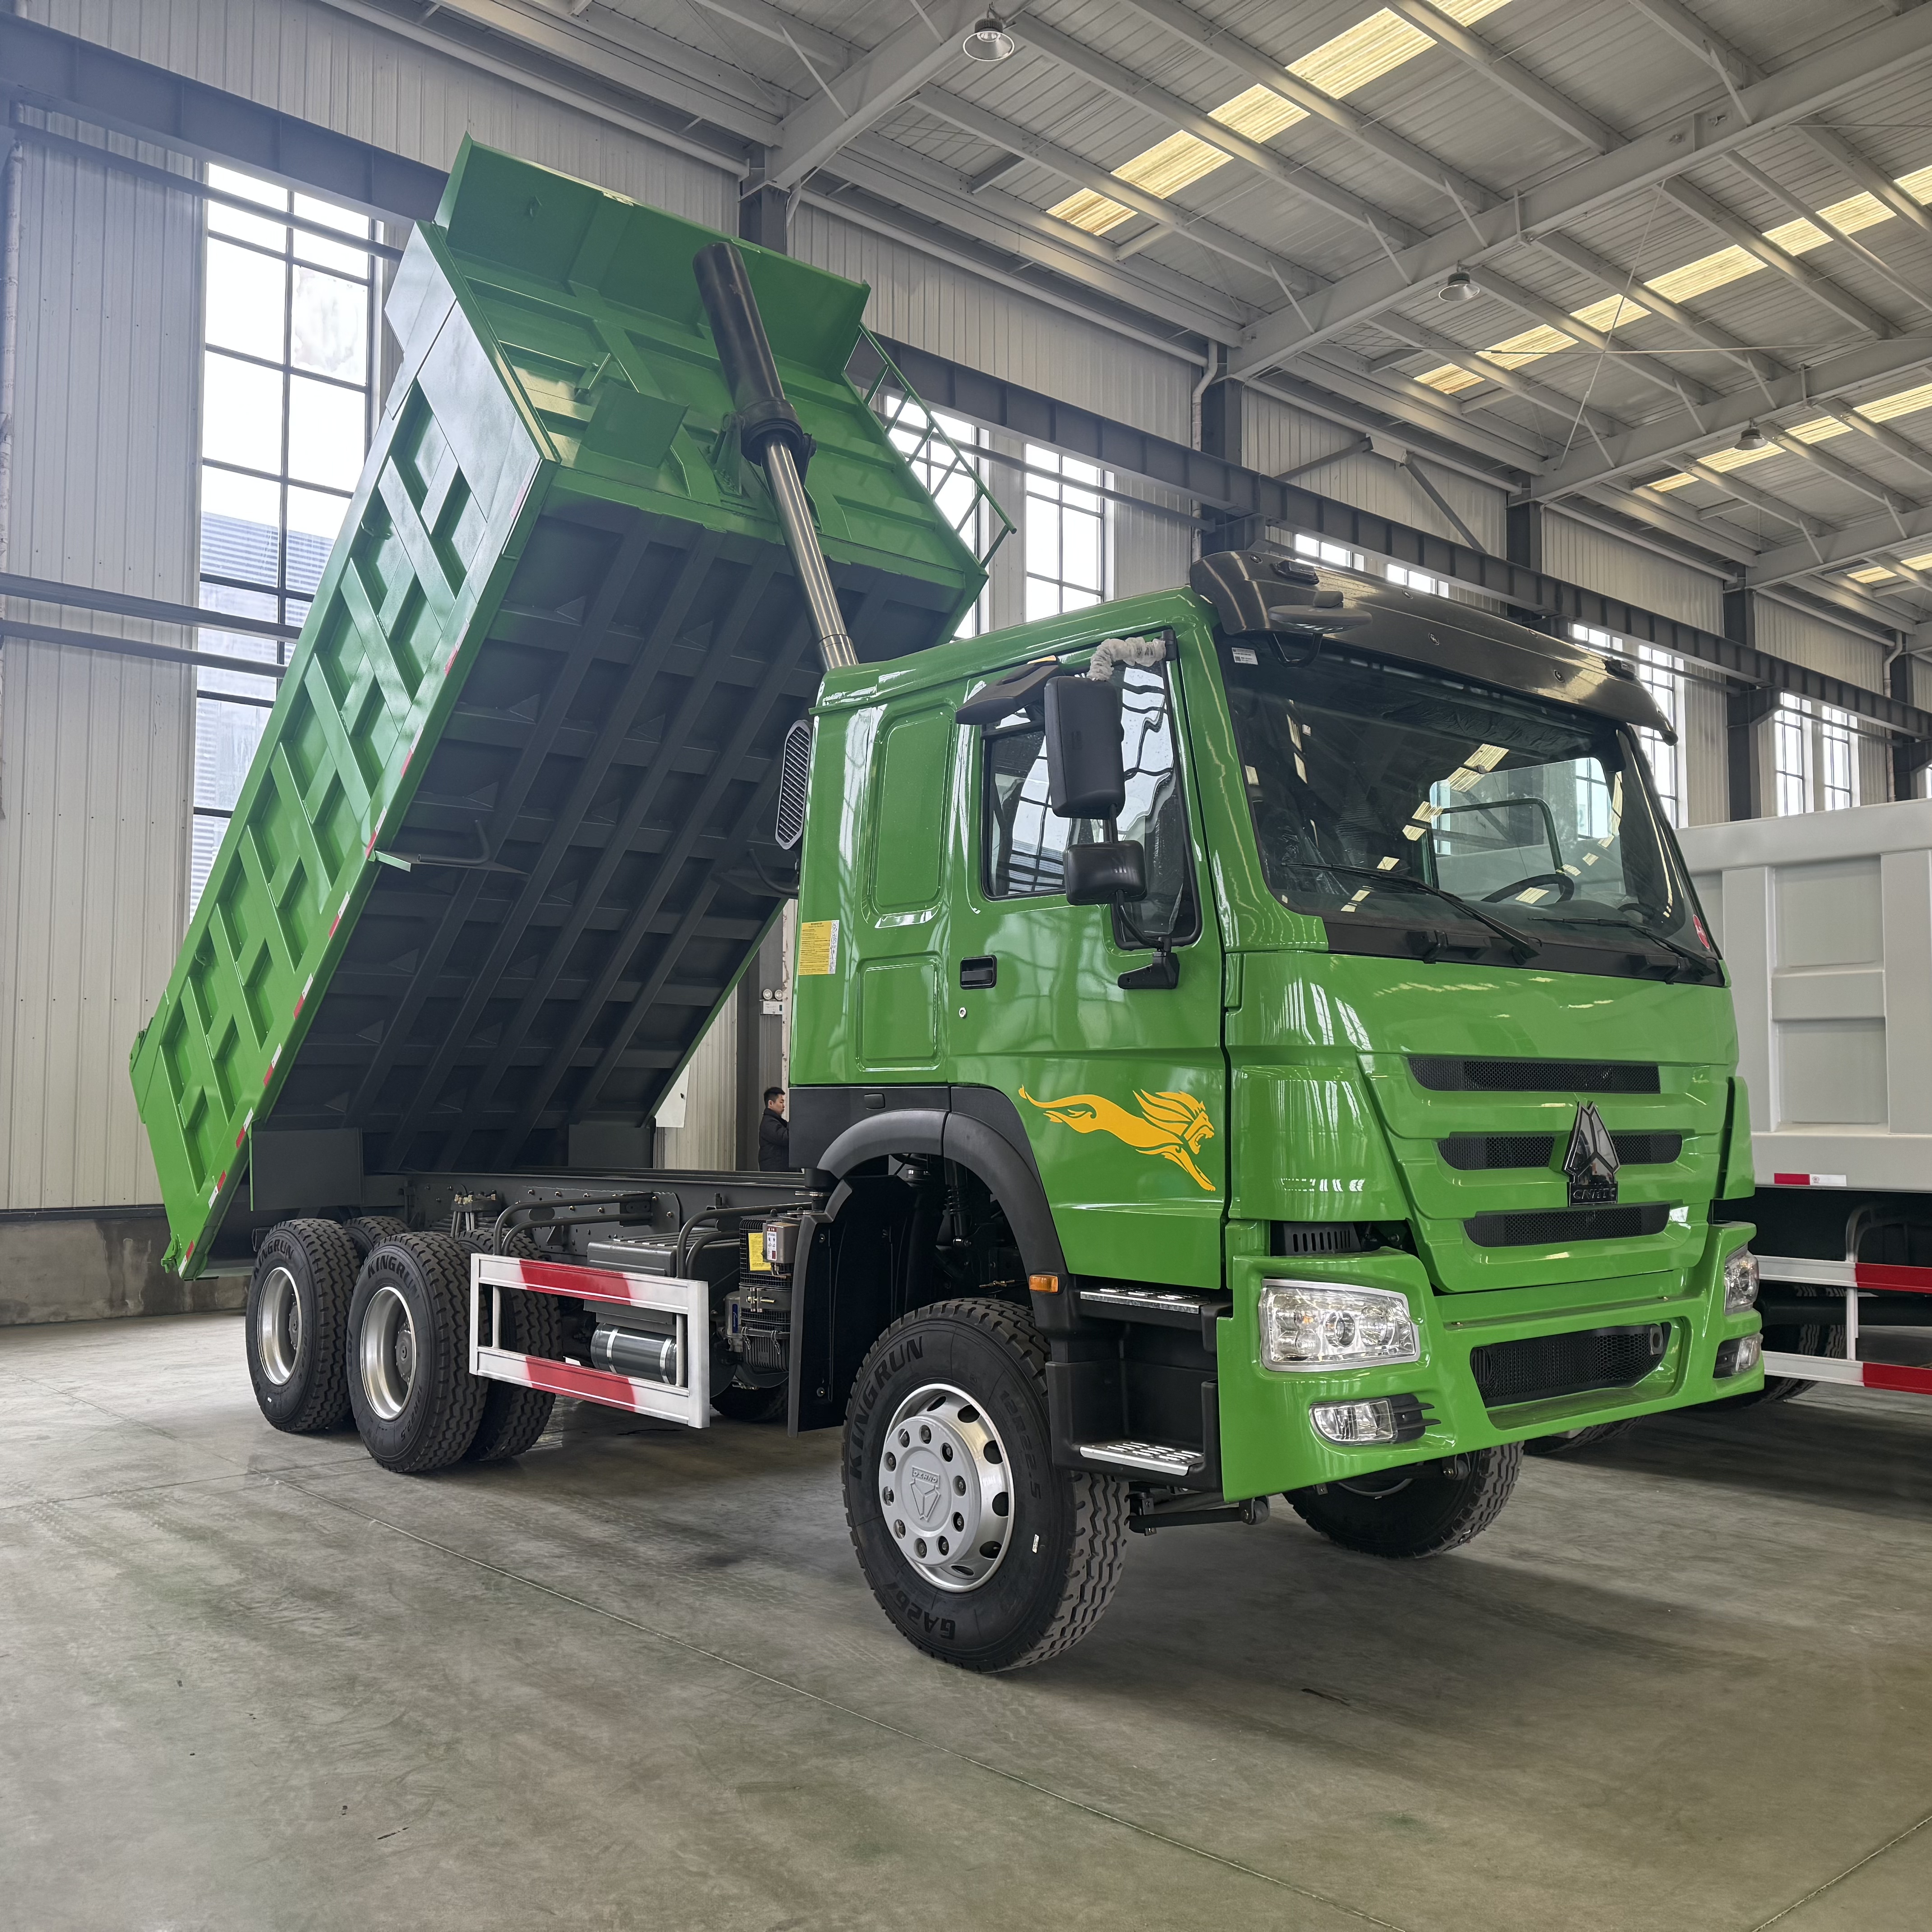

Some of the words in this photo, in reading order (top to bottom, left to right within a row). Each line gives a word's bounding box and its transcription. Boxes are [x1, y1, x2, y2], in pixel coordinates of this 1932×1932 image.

[1573, 1187, 1616, 1200] CNHTC
[254, 1239, 294, 1281] KINGRUN
[368, 1254, 420, 1300] KINGRUN
[849, 1335, 924, 1480] KINGRUN
[999, 1390, 1041, 1500] 12R22.5
[913, 1471, 937, 1483] CNHTC
[882, 1582, 956, 1640] GA267
